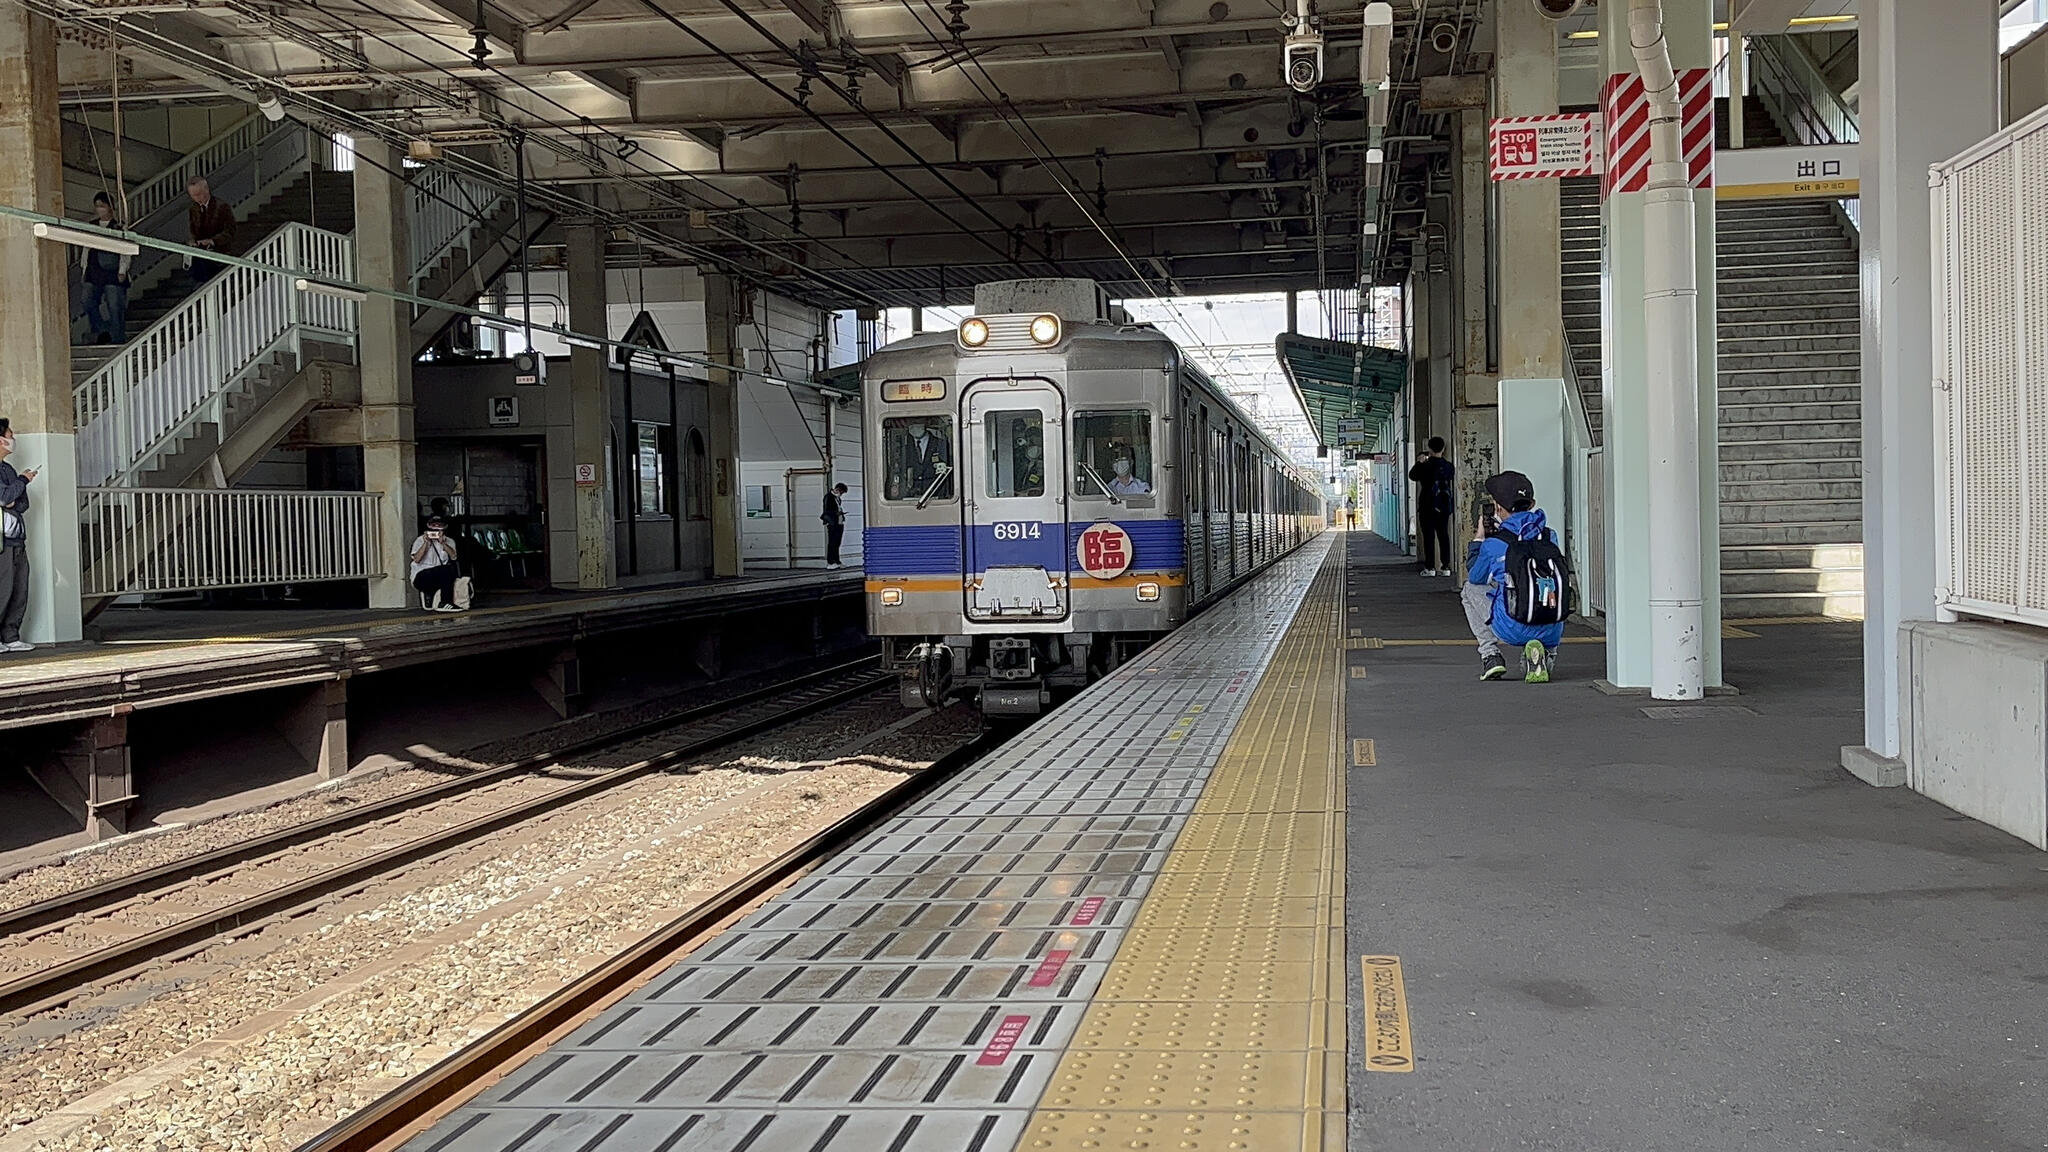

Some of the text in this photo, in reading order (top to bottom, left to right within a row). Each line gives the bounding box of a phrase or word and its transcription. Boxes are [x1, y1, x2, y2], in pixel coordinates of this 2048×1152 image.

[1538, 126, 1582, 135] 列車非常停止ボタン
[1501, 133, 1534, 144] STOP
[1798, 160, 1840, 177] 出口
[898, 383, 932, 395] 臨時
[994, 523, 1041, 540] 6914
[1083, 530, 1125, 571] 臨
